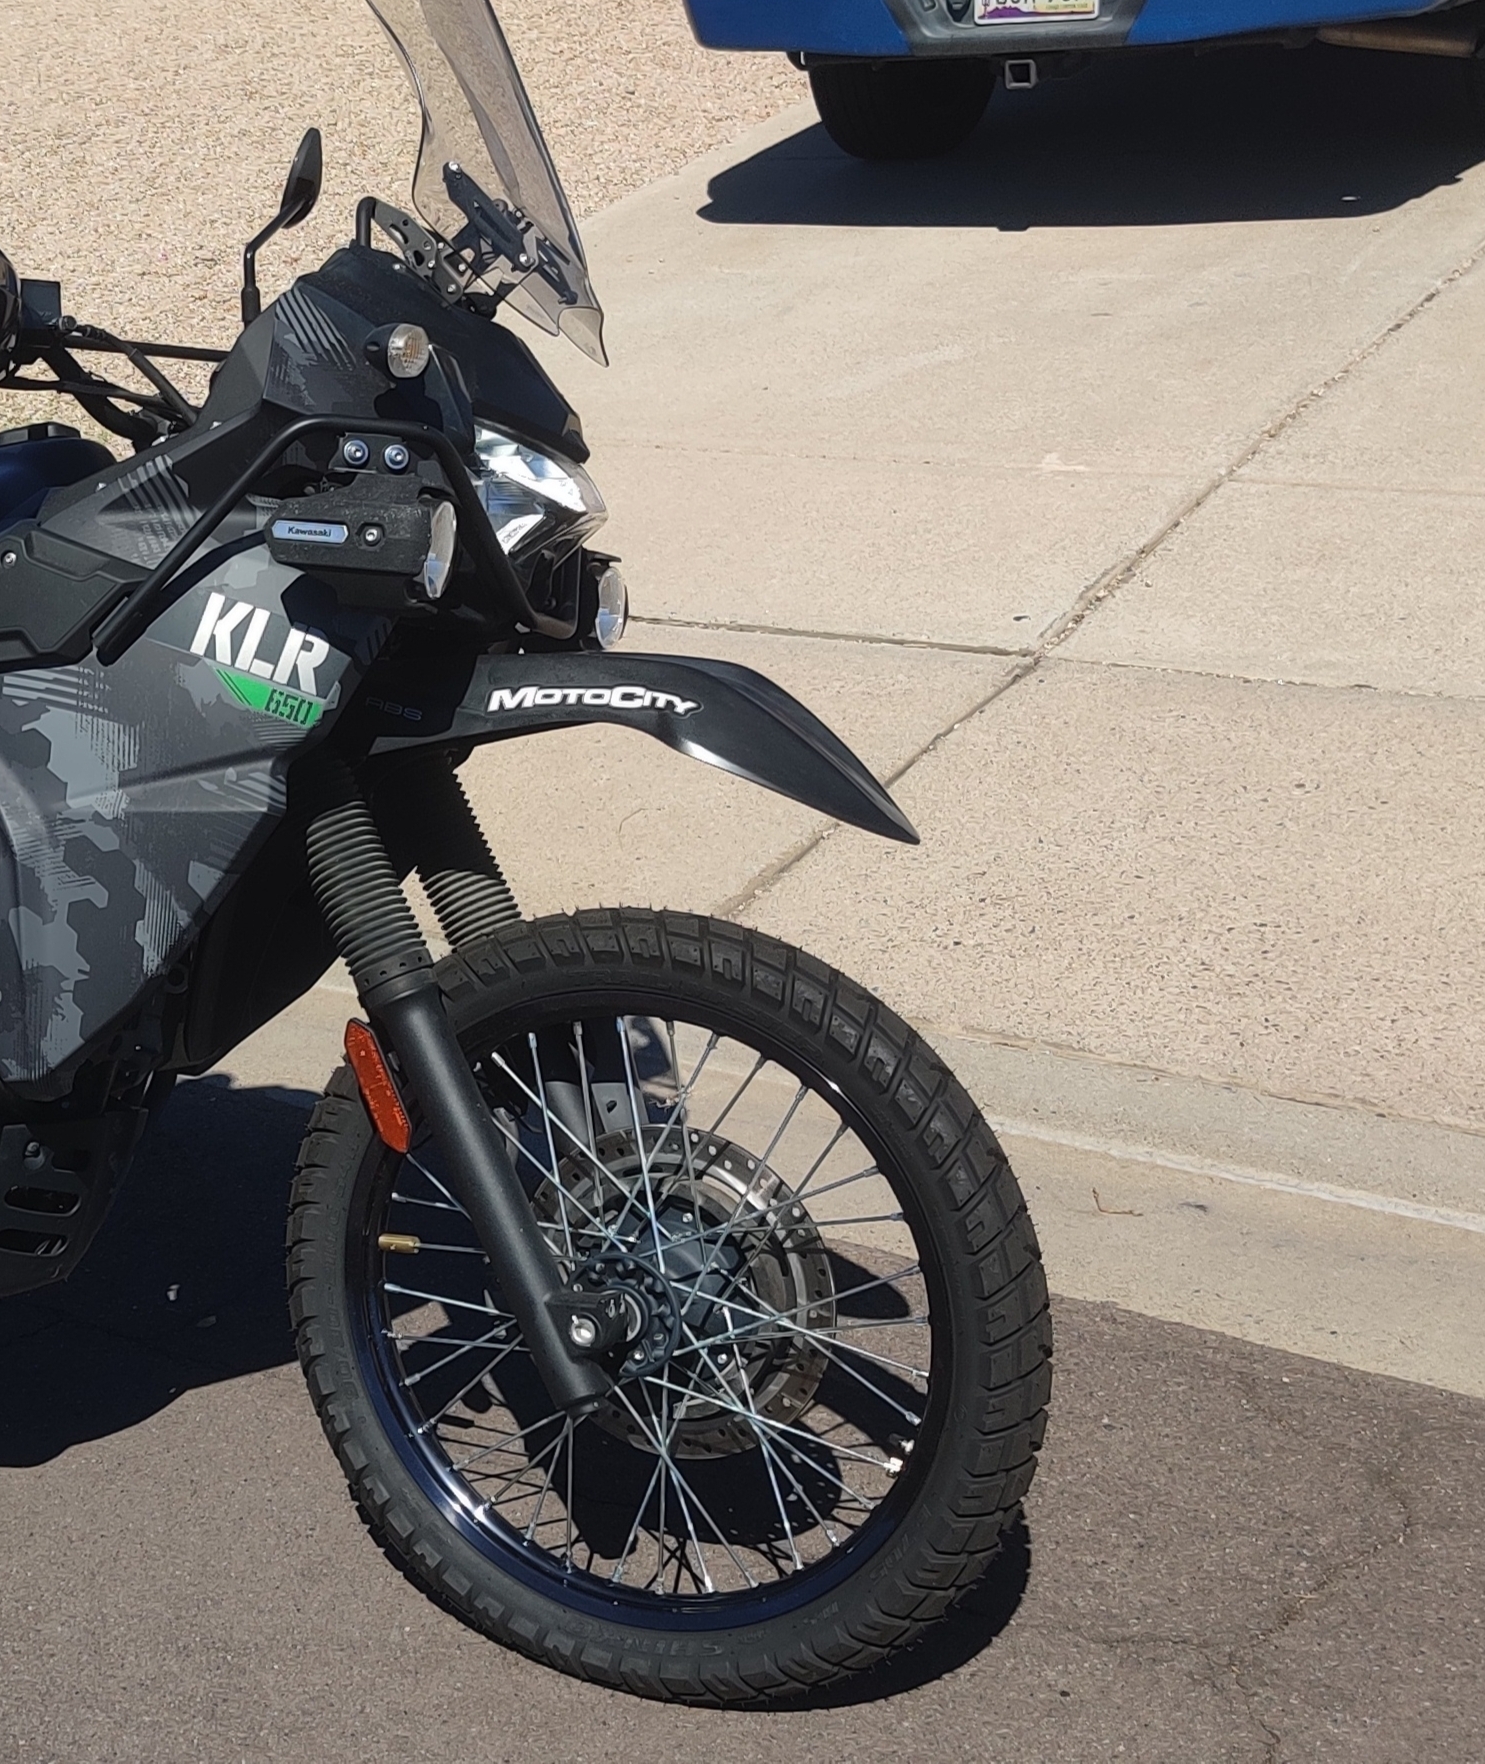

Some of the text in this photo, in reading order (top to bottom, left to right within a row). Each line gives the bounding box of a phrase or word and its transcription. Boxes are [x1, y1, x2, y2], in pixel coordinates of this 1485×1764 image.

[287, 526, 332, 537] Kawasaki
[190, 592, 329, 695] KLR
[265, 689, 313, 725] 650
[365, 696, 423, 721] ABS
